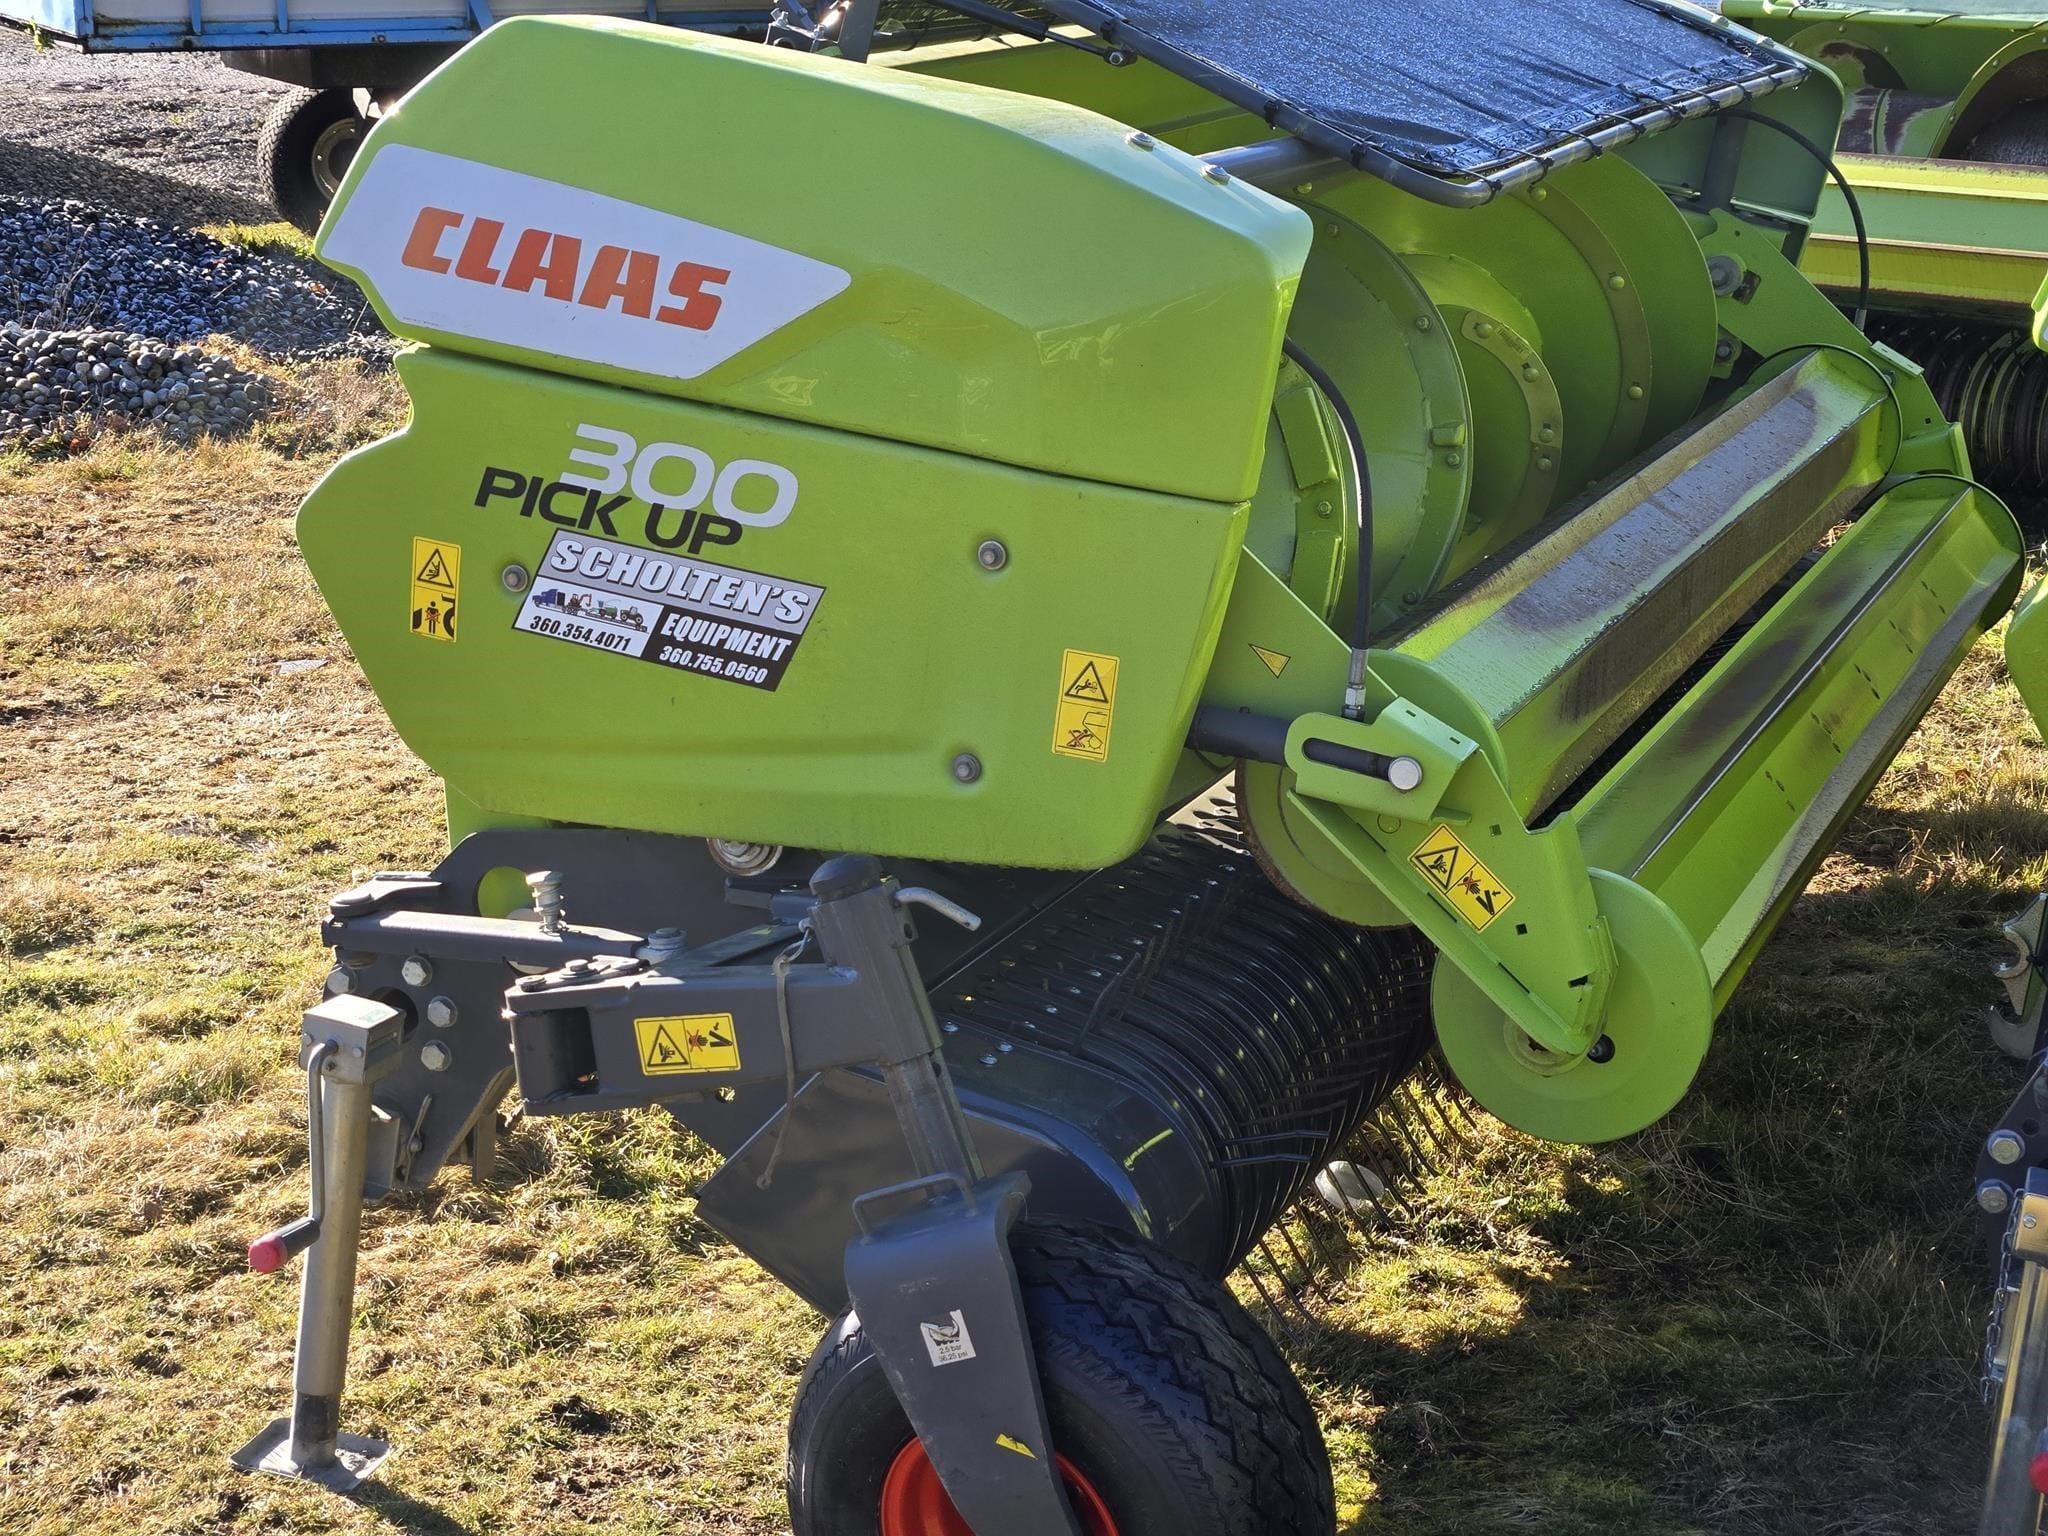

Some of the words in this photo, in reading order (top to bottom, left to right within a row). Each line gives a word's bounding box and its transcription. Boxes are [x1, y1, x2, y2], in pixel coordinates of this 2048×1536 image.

[401, 206, 731, 331] CLAAS
[474, 466, 632, 537] PICK
[644, 502, 743, 554] UP
[560, 423, 799, 528] 300
[550, 539, 809, 624] SCHOLTEN'S
[530, 615, 632, 652] 360.354.4071
[659, 646, 769, 684] 360.755.0560
[660, 613, 793, 662] EQUIPMENT
